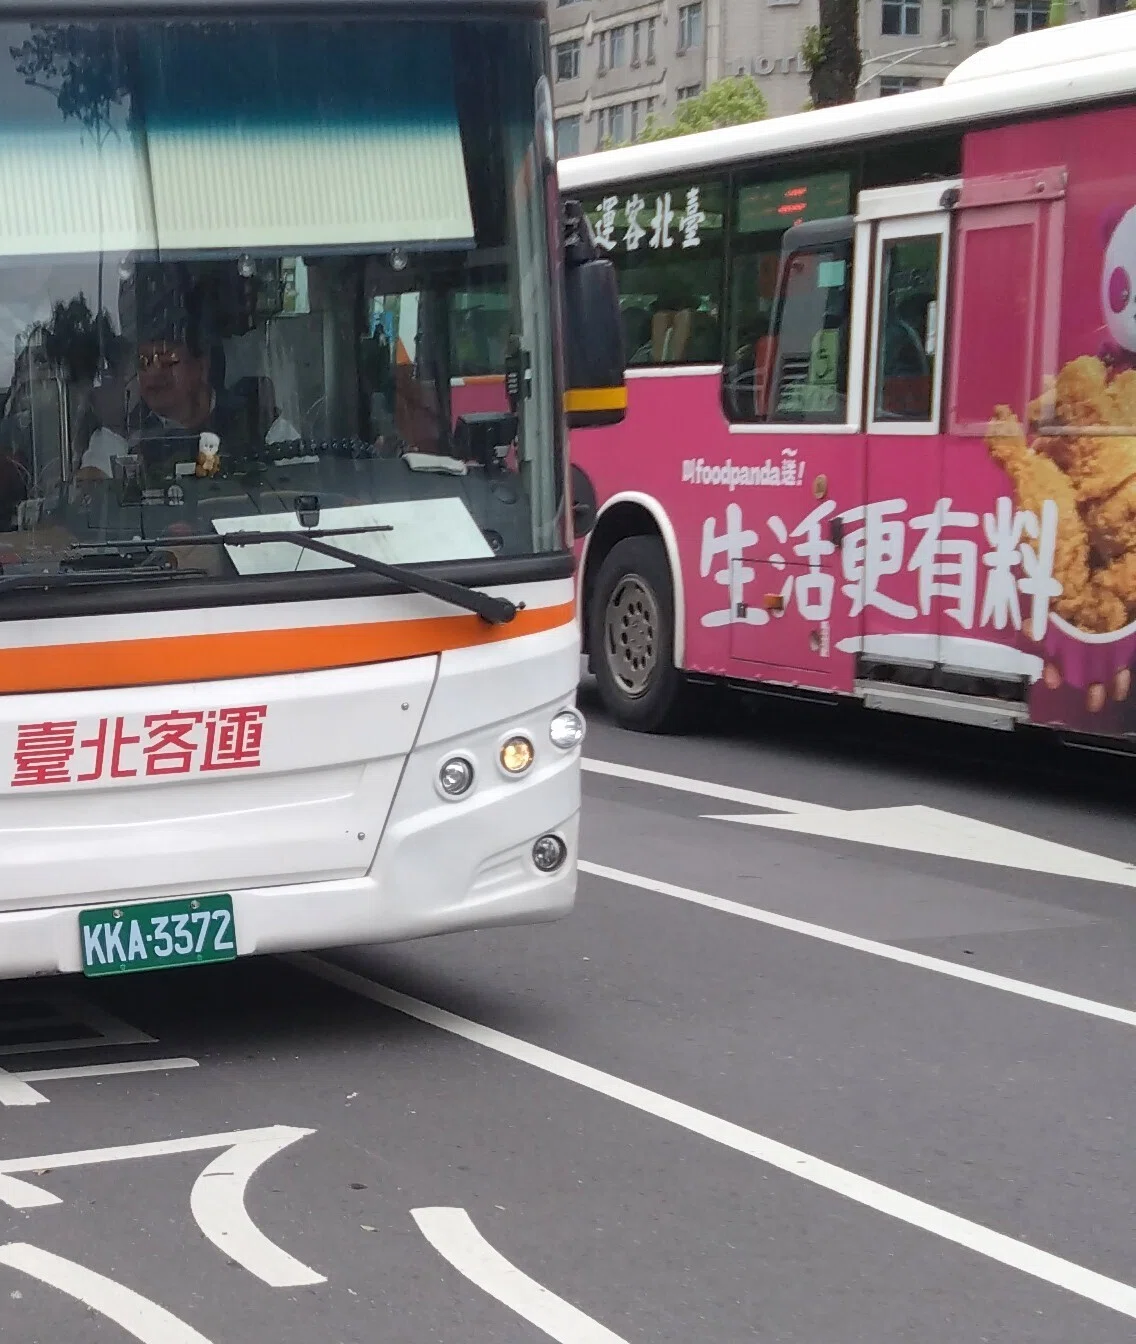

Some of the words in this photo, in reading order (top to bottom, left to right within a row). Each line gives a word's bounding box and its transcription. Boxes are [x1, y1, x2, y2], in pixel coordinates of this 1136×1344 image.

[700, 495, 1064, 642] 生活更有料
[11, 704, 268, 787] 臺北客運
